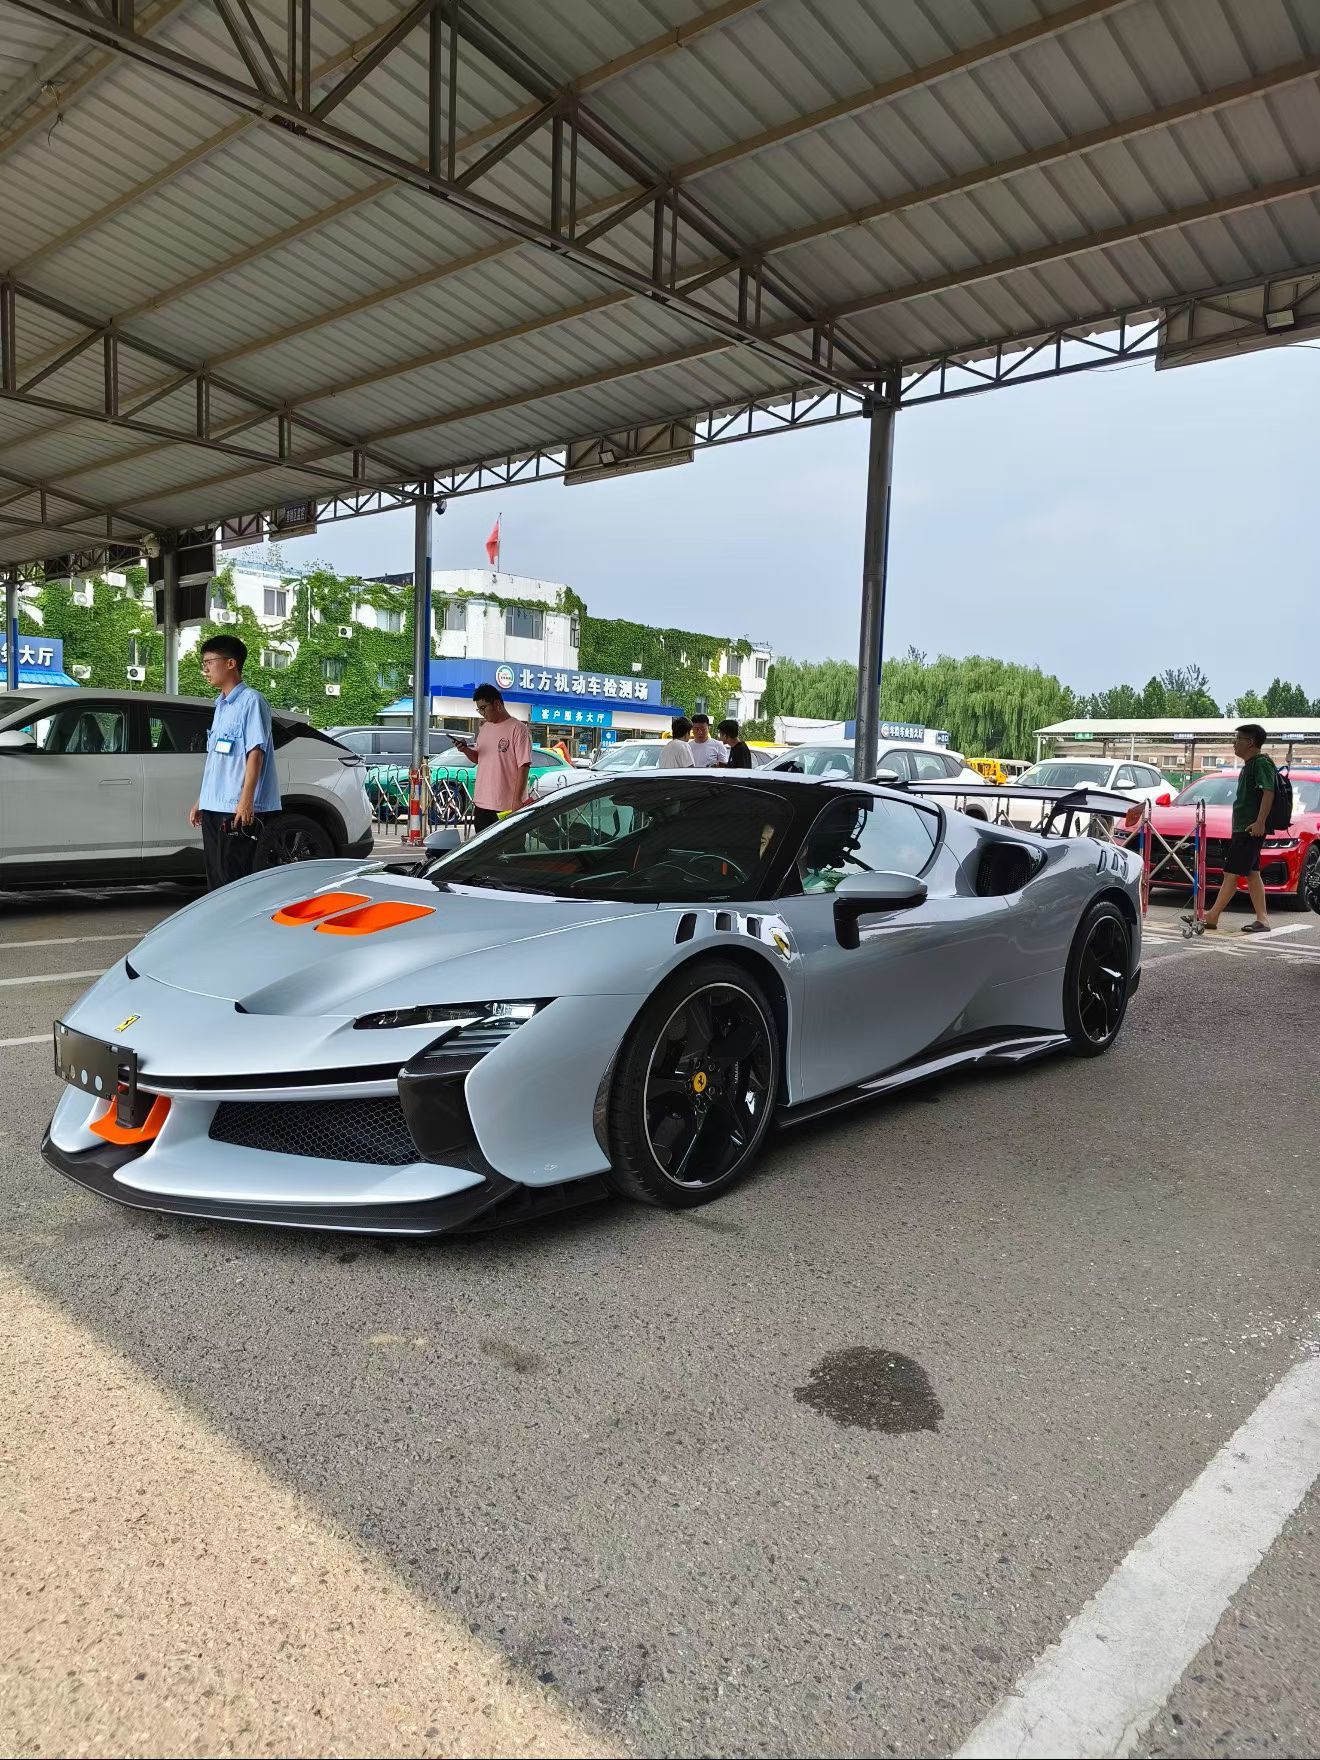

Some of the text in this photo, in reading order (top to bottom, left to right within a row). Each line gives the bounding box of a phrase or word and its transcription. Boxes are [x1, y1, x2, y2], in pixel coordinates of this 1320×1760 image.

[519, 668, 649, 700] 北方机动车检测场
[541, 709, 605, 724] 客户服务大厅
